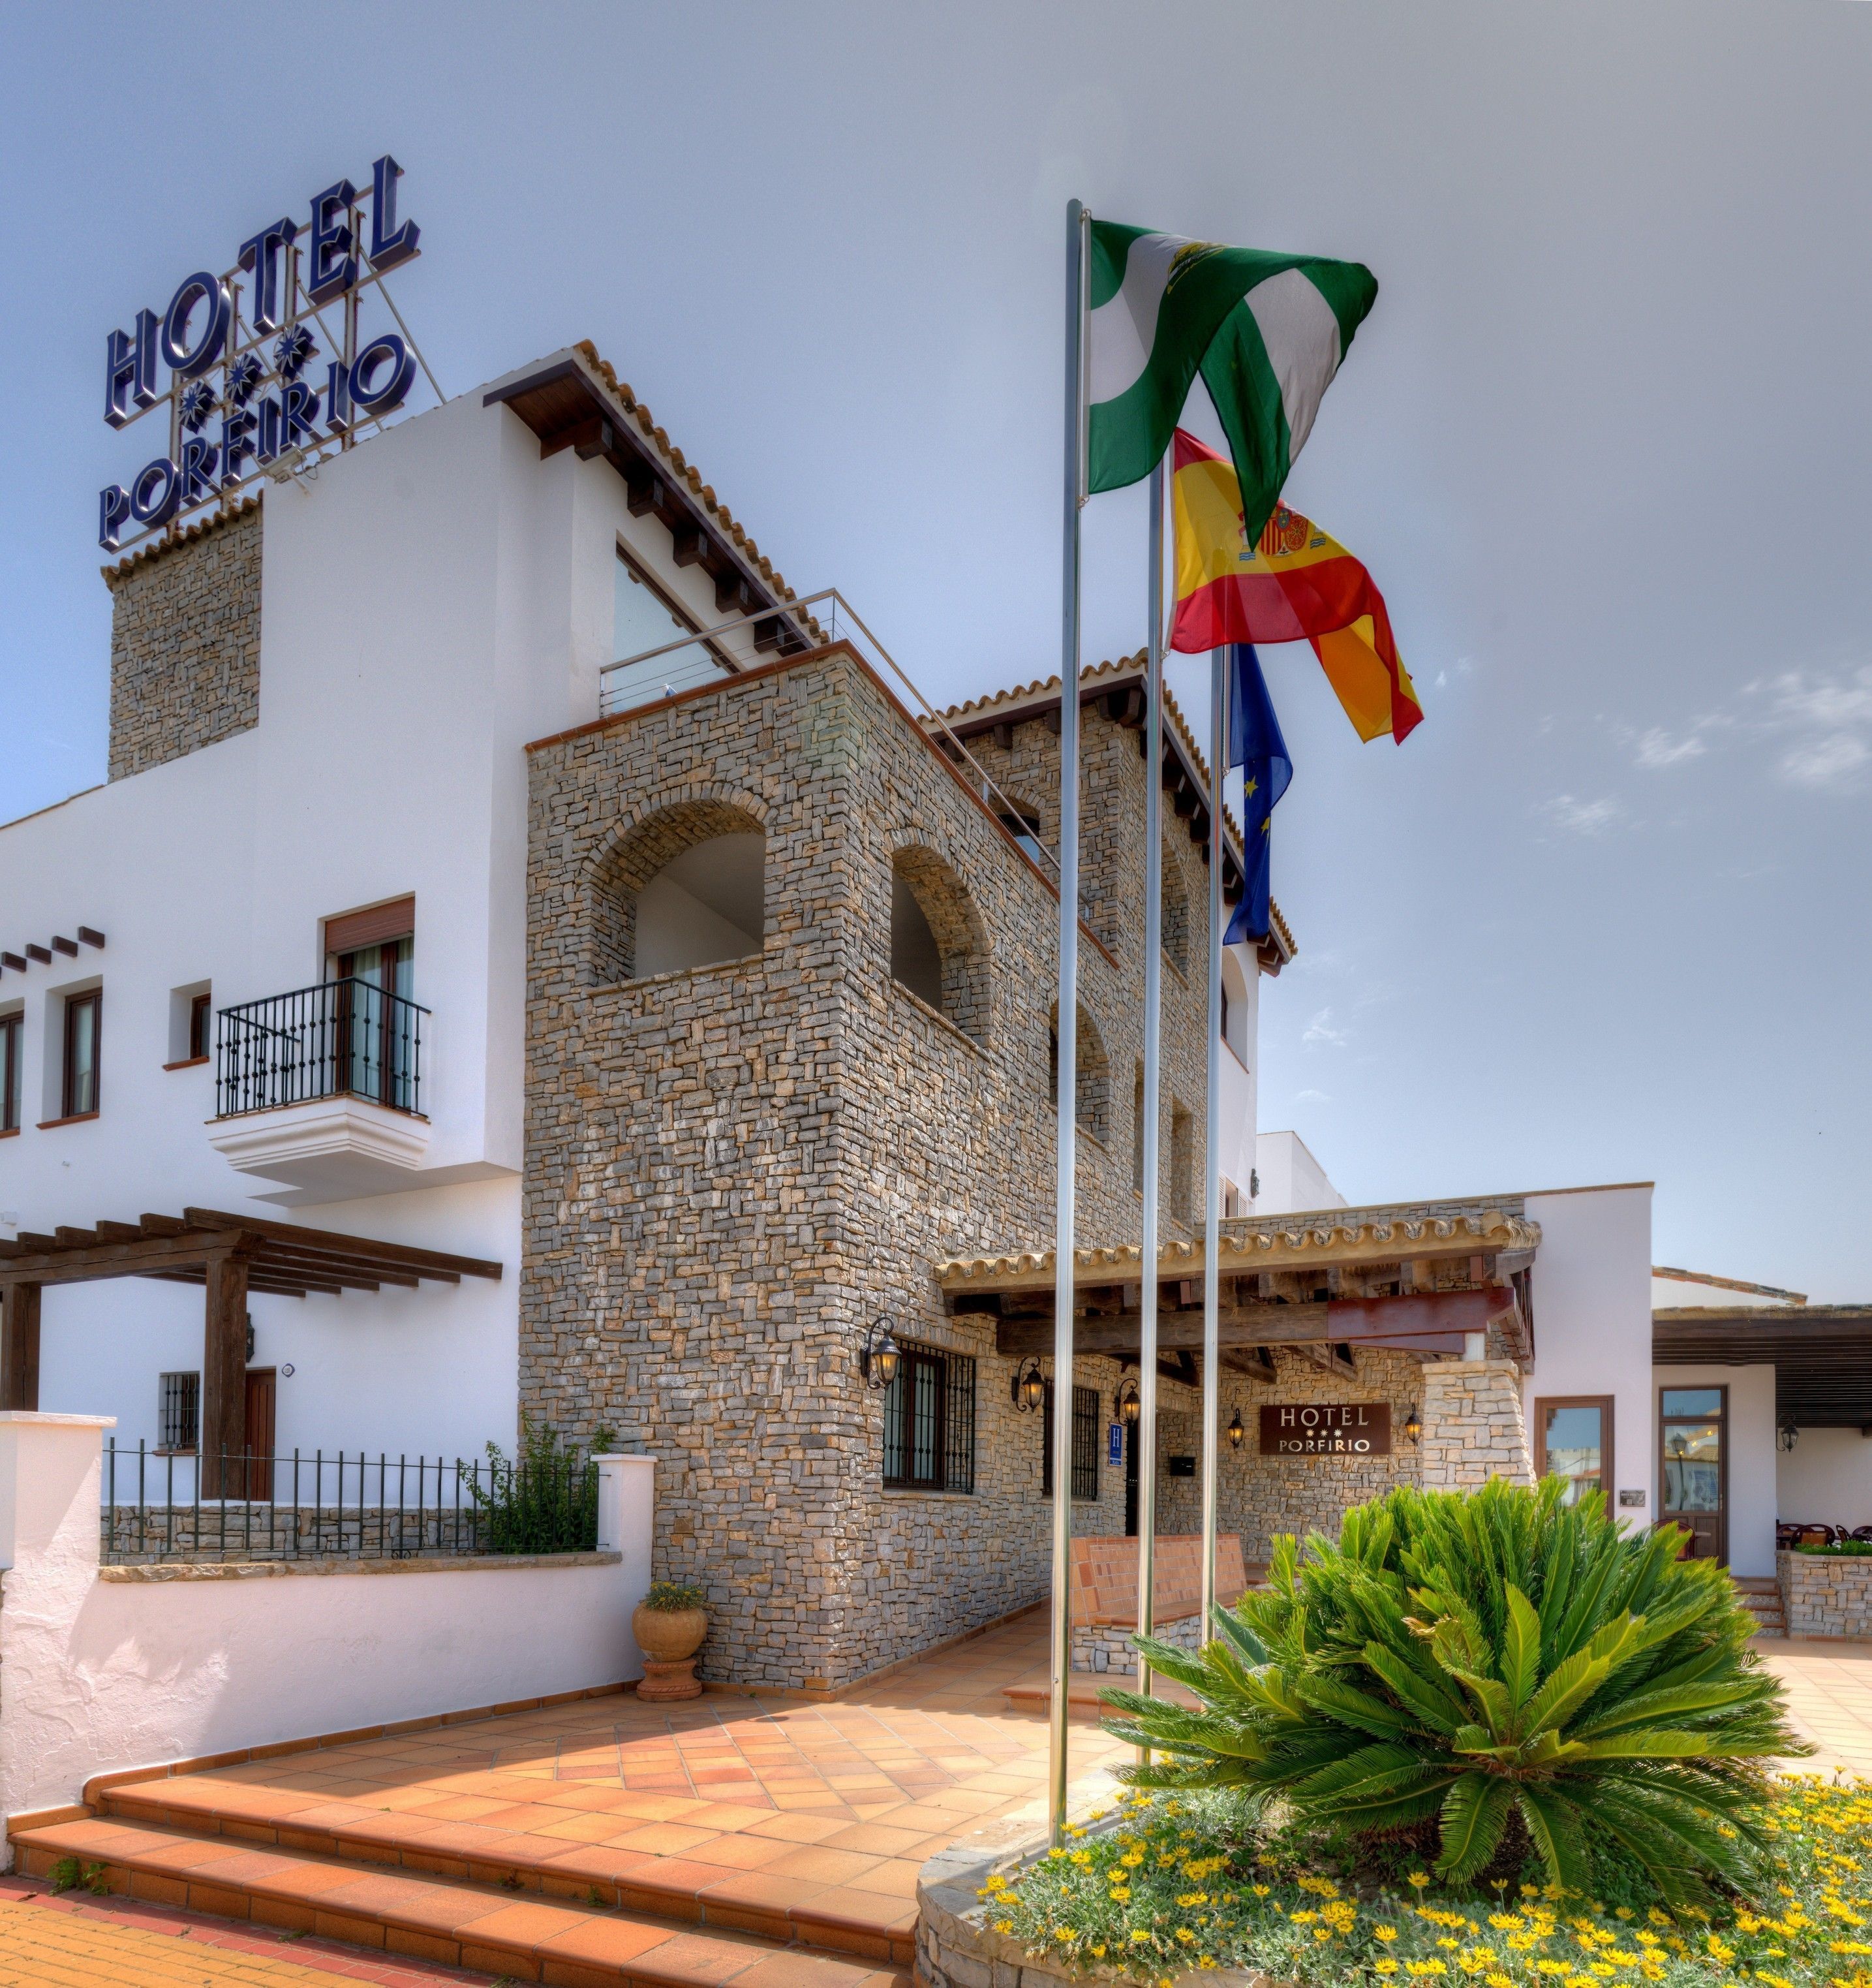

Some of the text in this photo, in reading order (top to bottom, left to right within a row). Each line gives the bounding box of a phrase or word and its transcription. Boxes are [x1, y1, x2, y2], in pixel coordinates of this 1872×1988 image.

[104, 154, 421, 431] HOTEL
[99, 334, 416, 553] PORFIRIO
[1281, 1407, 1368, 1427] HOTEL
[1112, 1428, 1120, 1448] H
[1280, 1439, 1370, 1452] PORFIRIO
